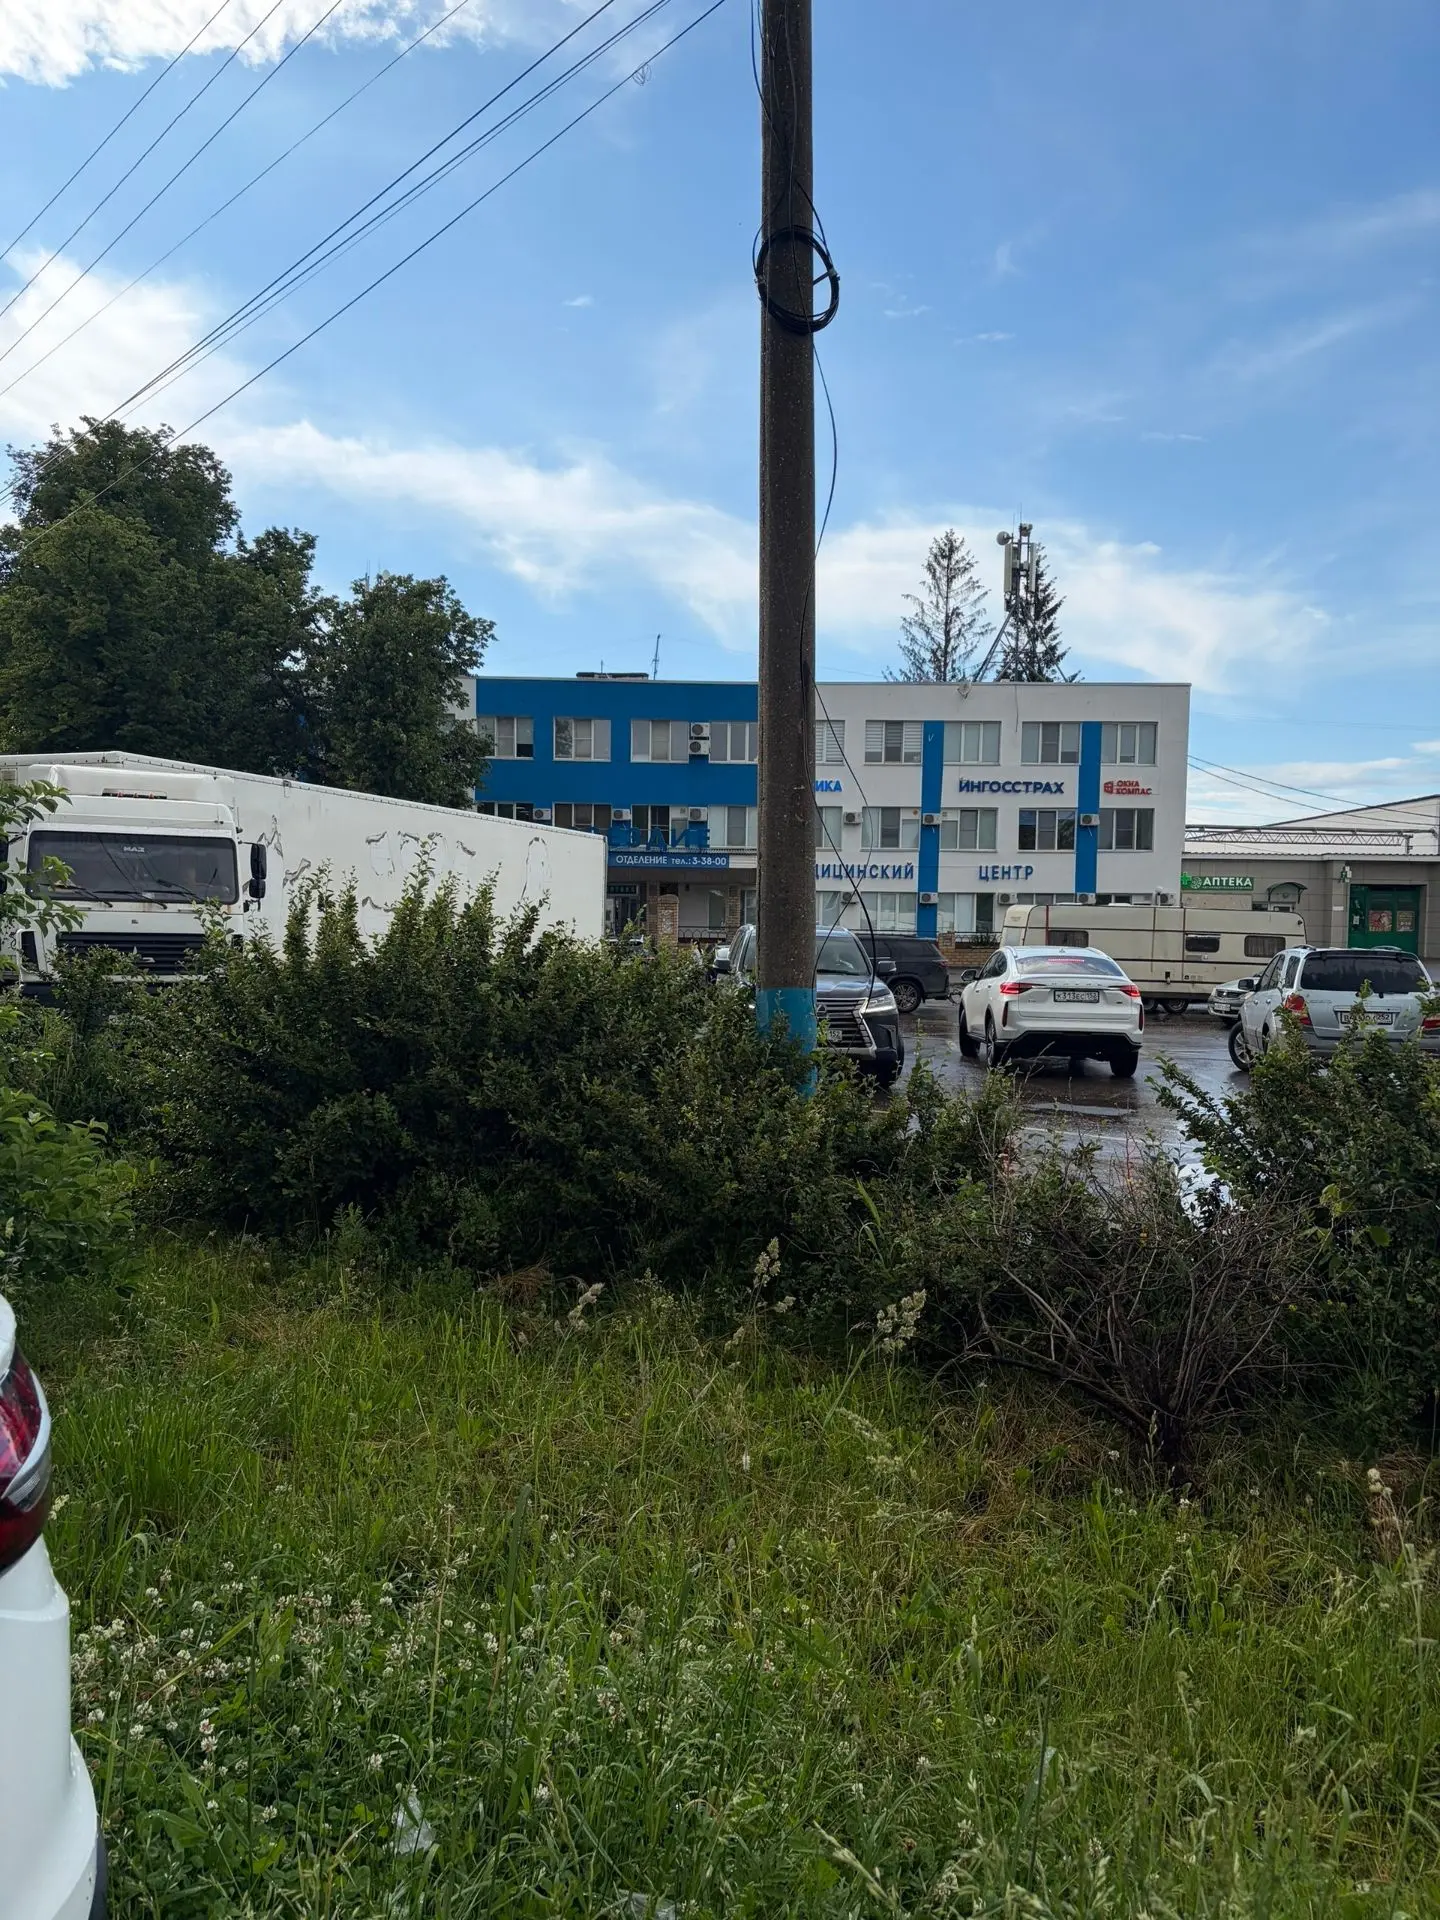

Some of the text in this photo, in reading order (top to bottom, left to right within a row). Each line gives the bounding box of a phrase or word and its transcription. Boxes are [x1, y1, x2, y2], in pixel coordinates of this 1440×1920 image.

[959, 779, 1065, 794] ИНГОССТРАХ
[1115, 787, 1153, 795] КОМПАС
[615, 855, 668, 865] ОТДЕЛЕНИЕ
[979, 865, 1034, 882] ЦЕНТР
[1203, 877, 1253, 886] АПТЕКА
